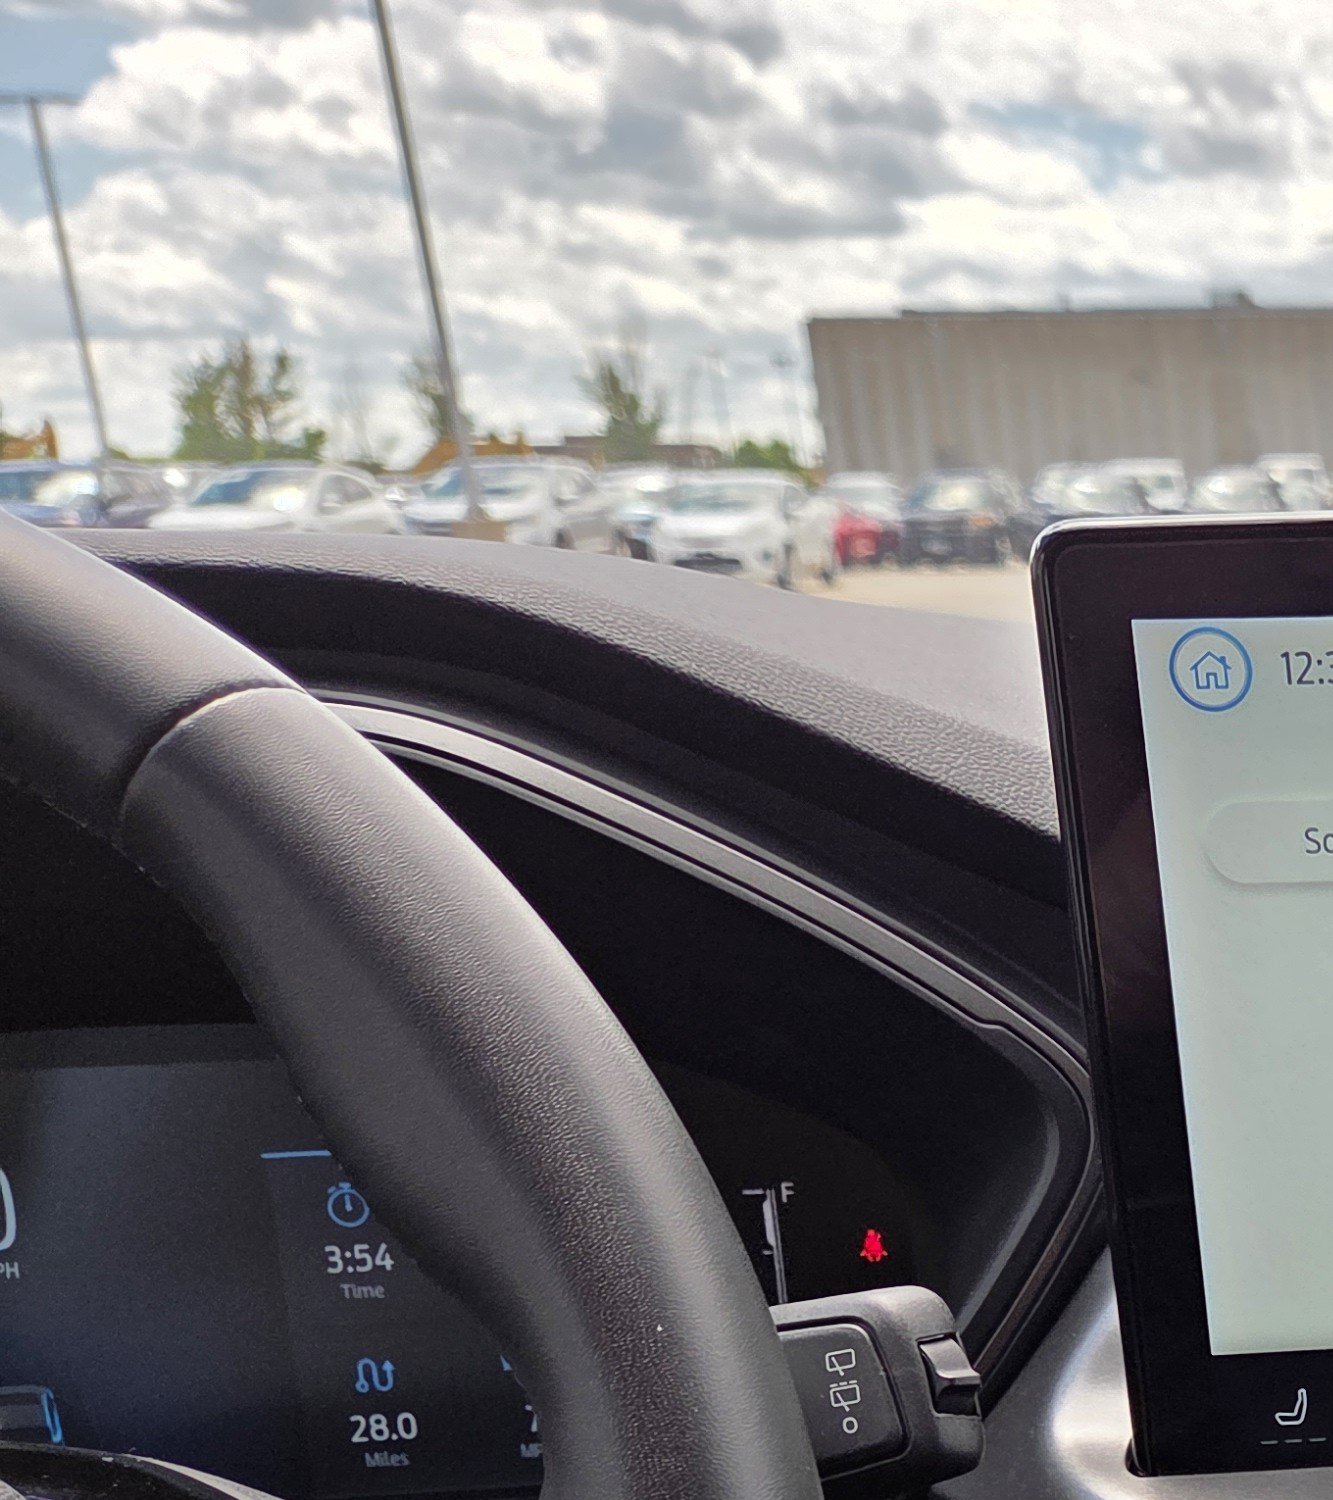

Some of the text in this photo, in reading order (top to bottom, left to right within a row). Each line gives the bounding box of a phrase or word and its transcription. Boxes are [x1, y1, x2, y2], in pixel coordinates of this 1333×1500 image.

[780, 1181, 795, 1203] F
[324, 1243, 395, 1275] 3:54
[340, 1282, 386, 1300] Time
[350, 1411, 418, 1444] 28.0
[365, 1451, 410, 1468] Miles
